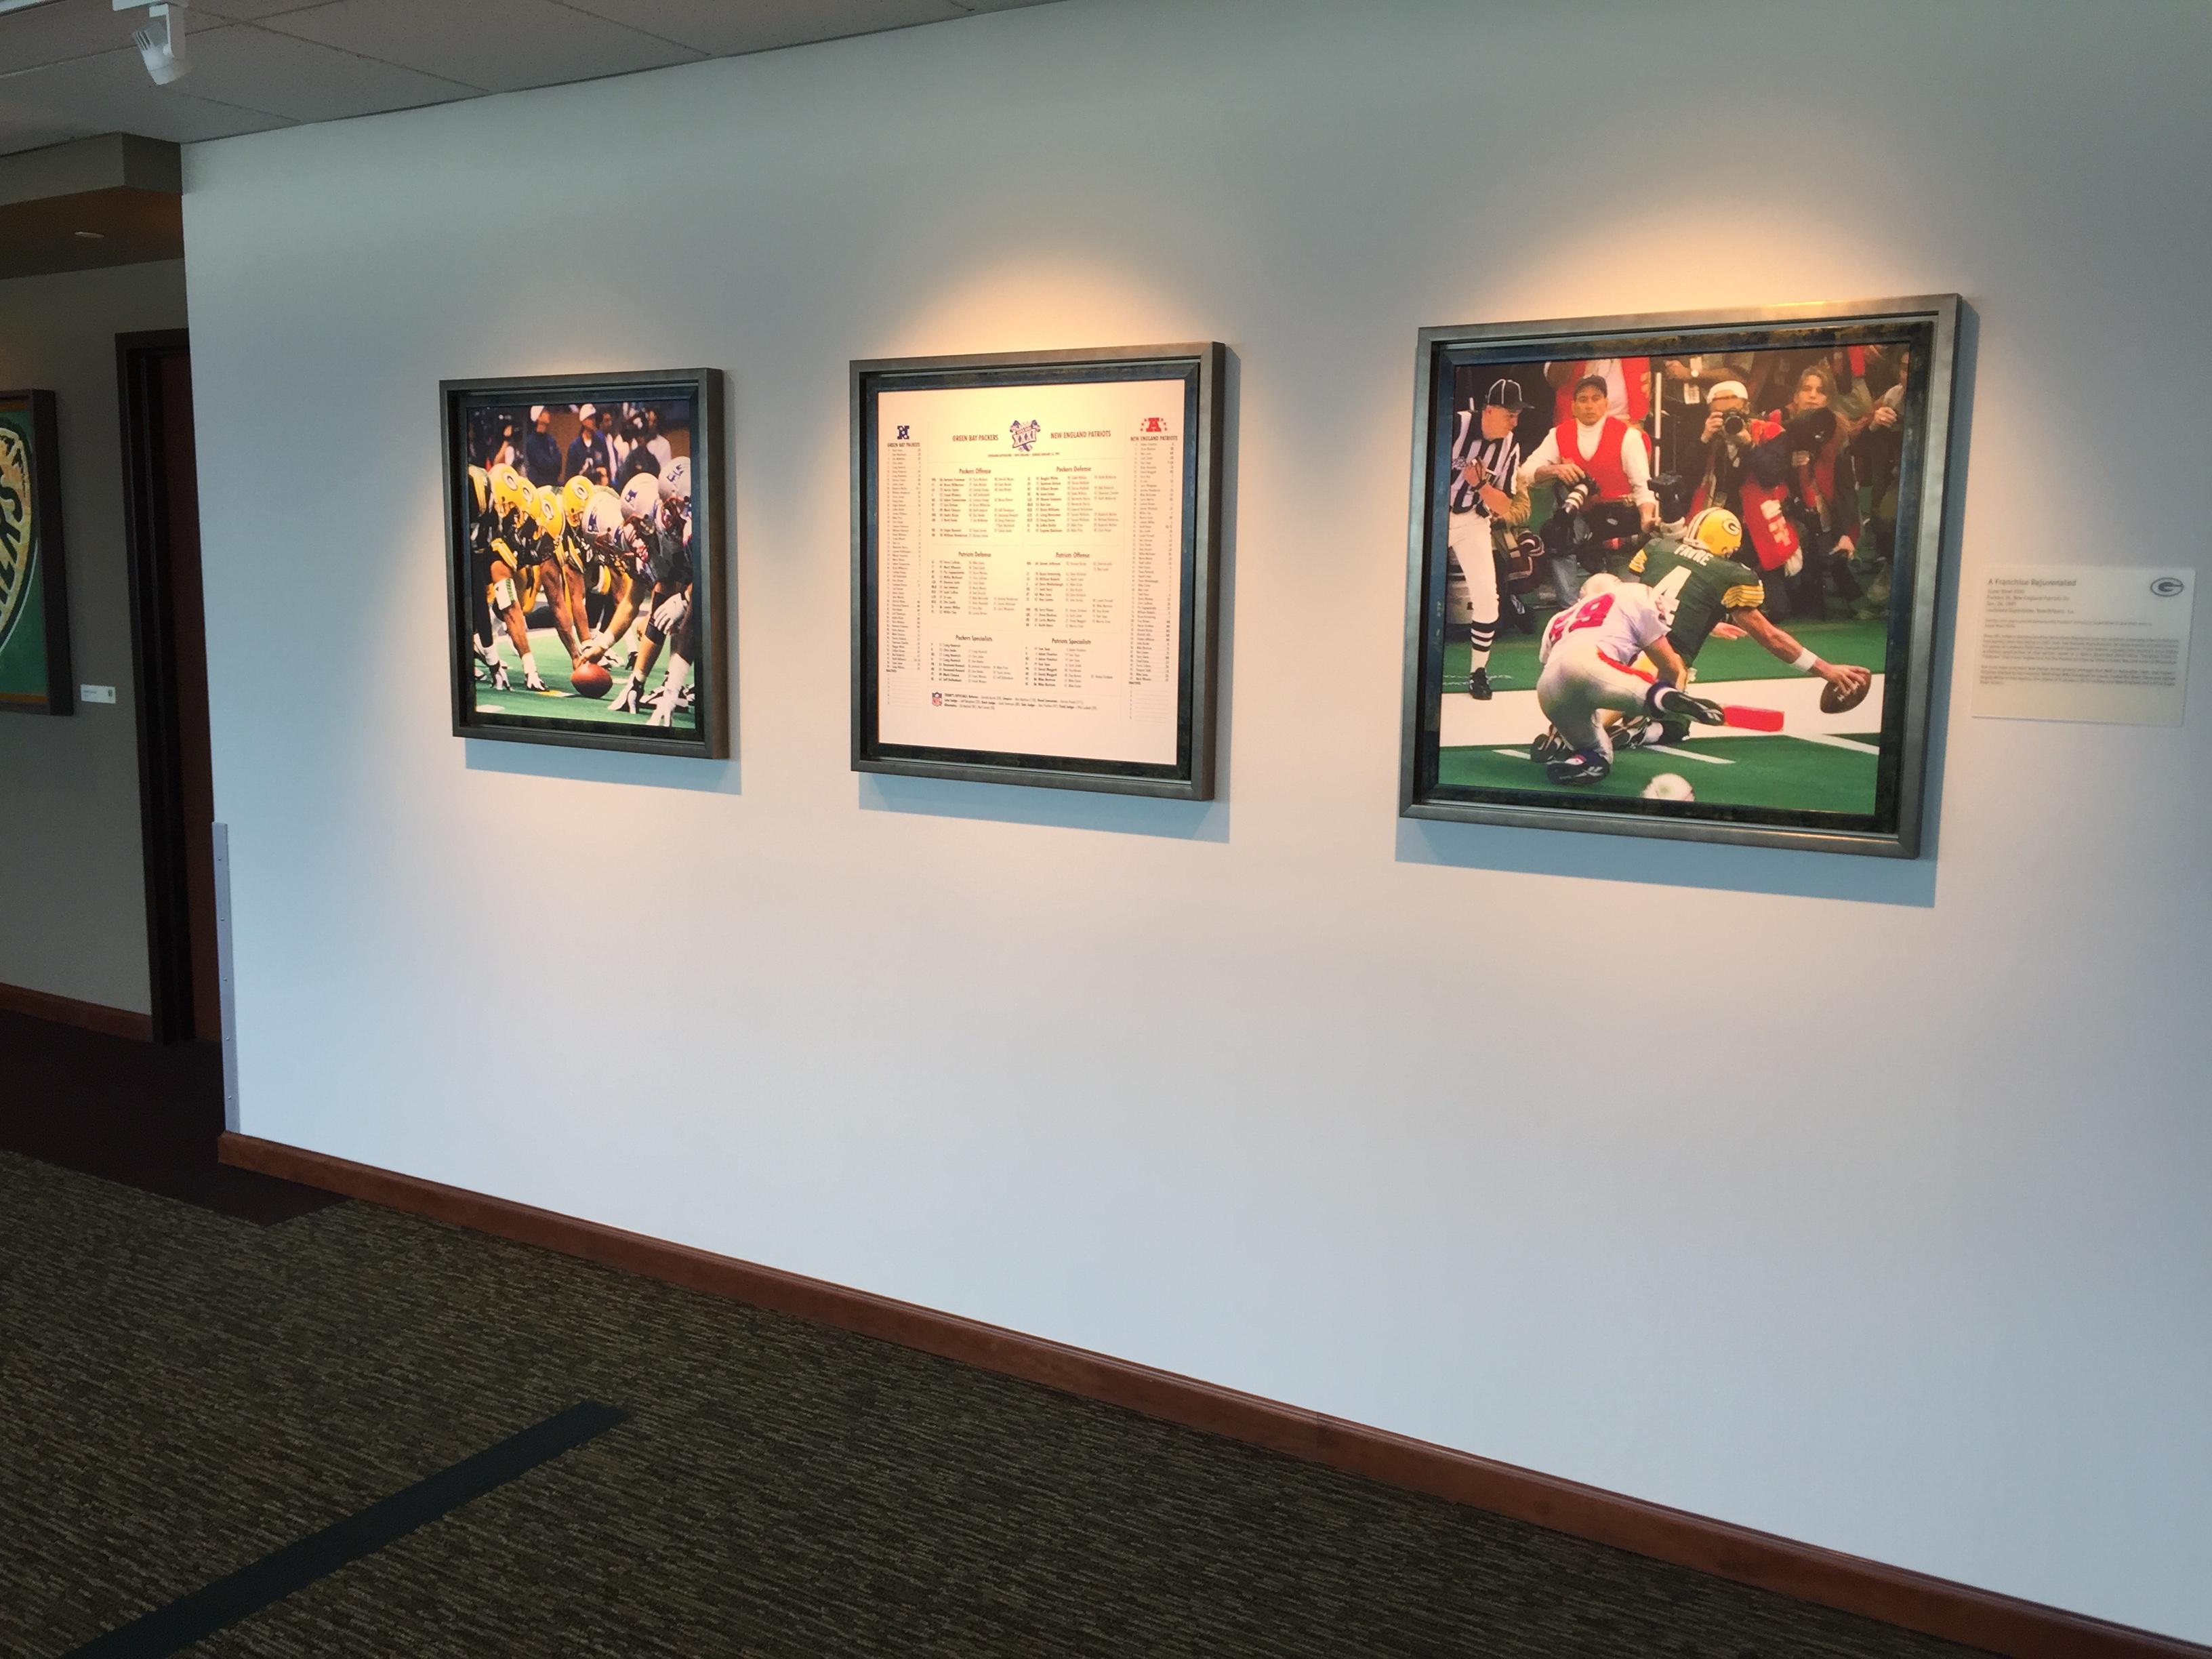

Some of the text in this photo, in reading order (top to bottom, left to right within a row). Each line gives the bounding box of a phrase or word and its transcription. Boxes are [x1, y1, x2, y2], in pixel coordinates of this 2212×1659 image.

[1674, 544, 1714, 567] FAVRE
[1995, 577, 2030, 586] Franchise
[2031, 578, 2076, 588] Rejuvenated
